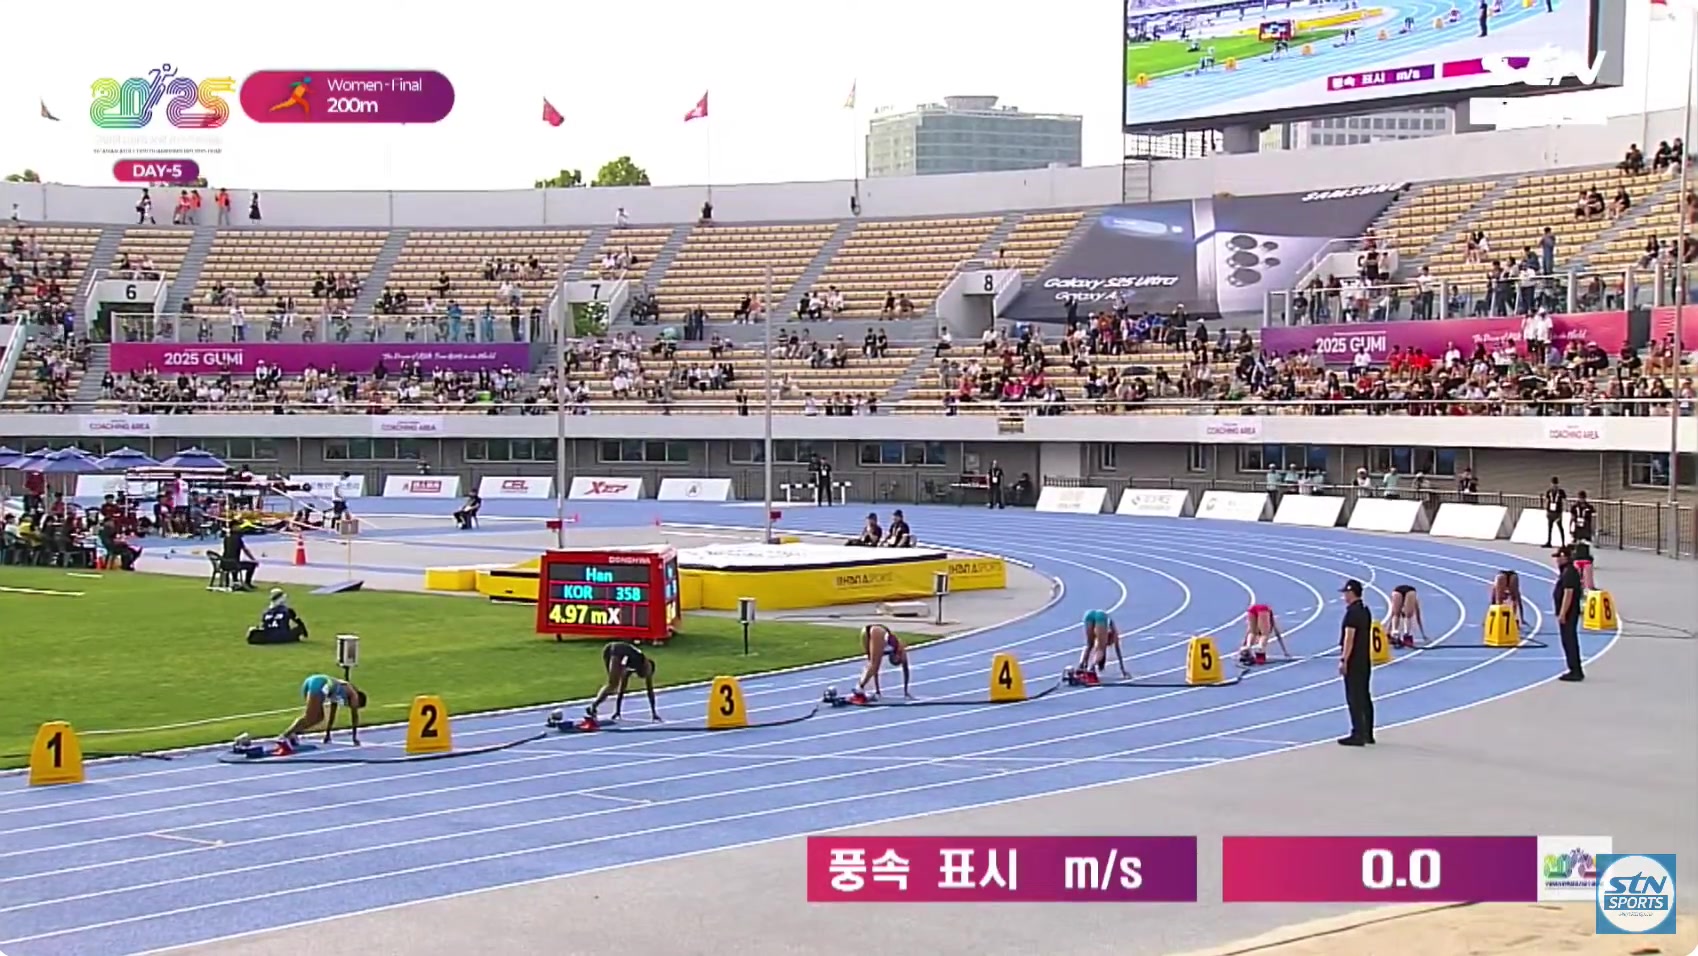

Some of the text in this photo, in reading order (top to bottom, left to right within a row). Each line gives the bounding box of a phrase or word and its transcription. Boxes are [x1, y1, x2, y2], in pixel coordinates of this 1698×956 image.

[126, 284, 137, 300] 6
[591, 284, 601, 300] 7
[984, 274, 993, 291] 8
[1044, 276, 1179, 290] Galaxy S25 Ultra
[1316, 336, 1386, 353] 2025 GUMI
[164, 352, 243, 366] 2025 GUMI
[585, 566, 613, 582] Han
[564, 585, 641, 601] KOR 358
[549, 604, 589, 624] 4.97
[1589, 596, 1596, 619] 8
[1604, 597, 1612, 620] 8
[1489, 612, 1496, 634] 7
[1502, 612, 1511, 635] 7
[1372, 628, 1381, 652] 6
[1201, 643, 1212, 670] 5
[999, 660, 1013, 689] 4
[719, 684, 735, 716] 3
[420, 704, 437, 738] 2
[47, 731, 62, 767] 1
